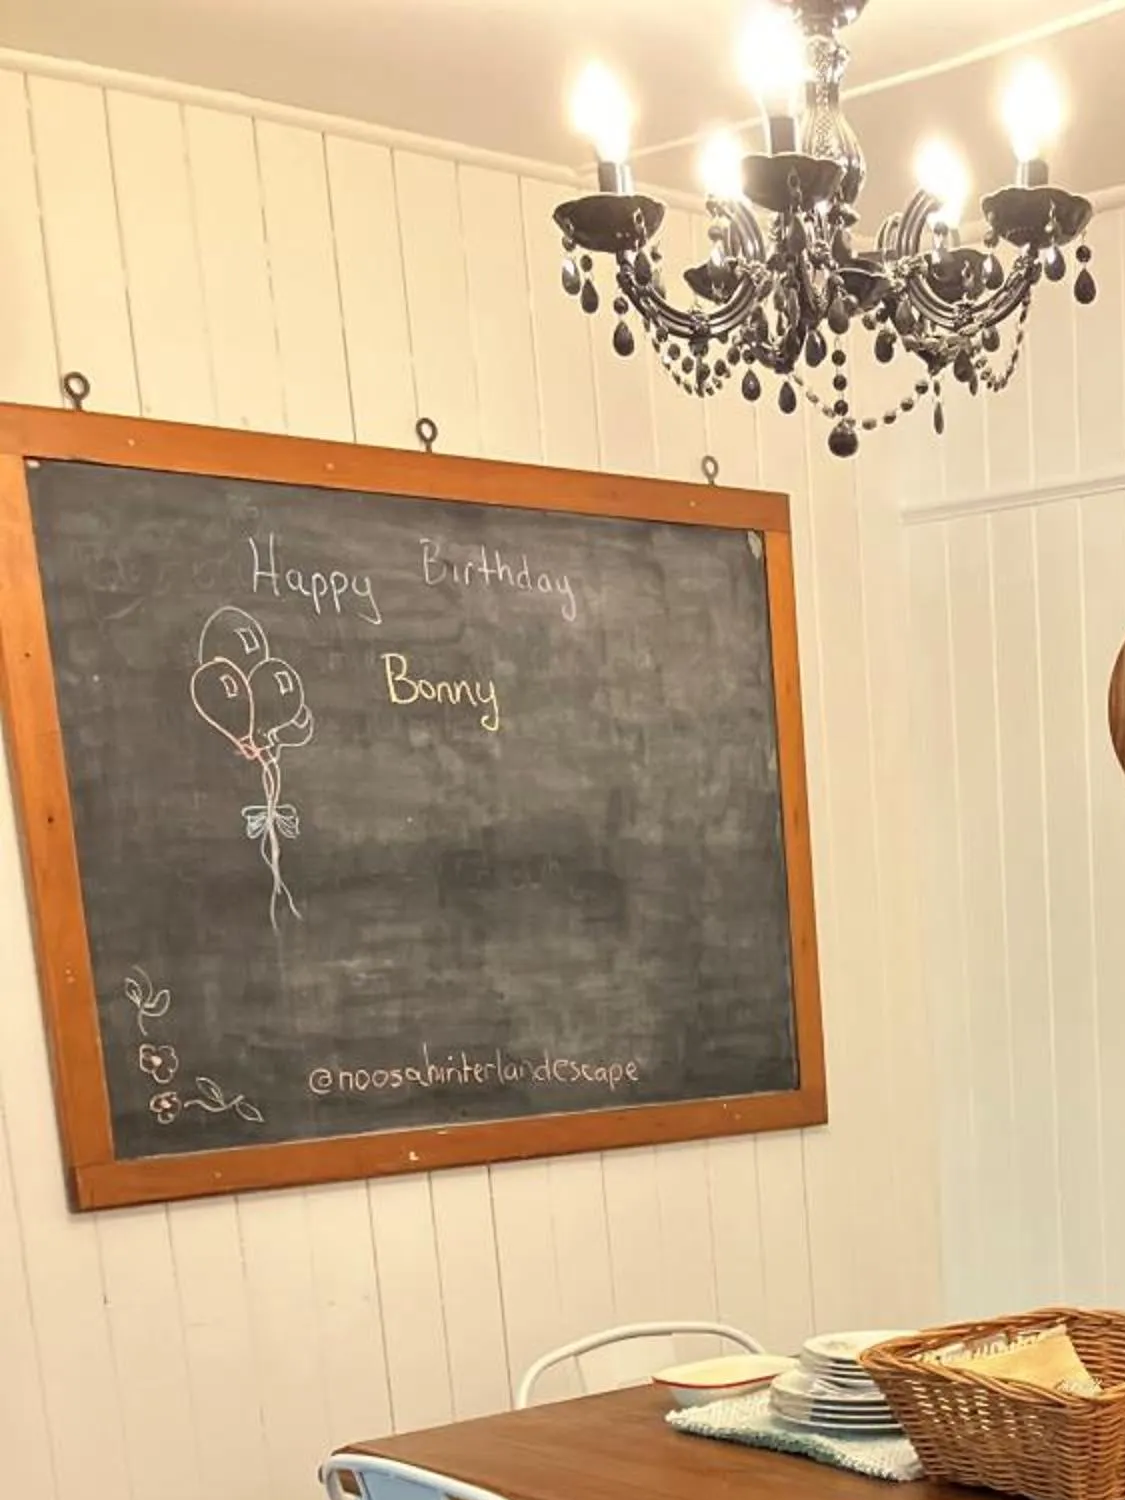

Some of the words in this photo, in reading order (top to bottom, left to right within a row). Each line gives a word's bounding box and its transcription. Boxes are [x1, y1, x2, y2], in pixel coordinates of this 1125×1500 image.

[248, 532, 382, 625] Happy
[419, 538, 578, 622] Birthday
[380, 652, 500, 732] Bonny
